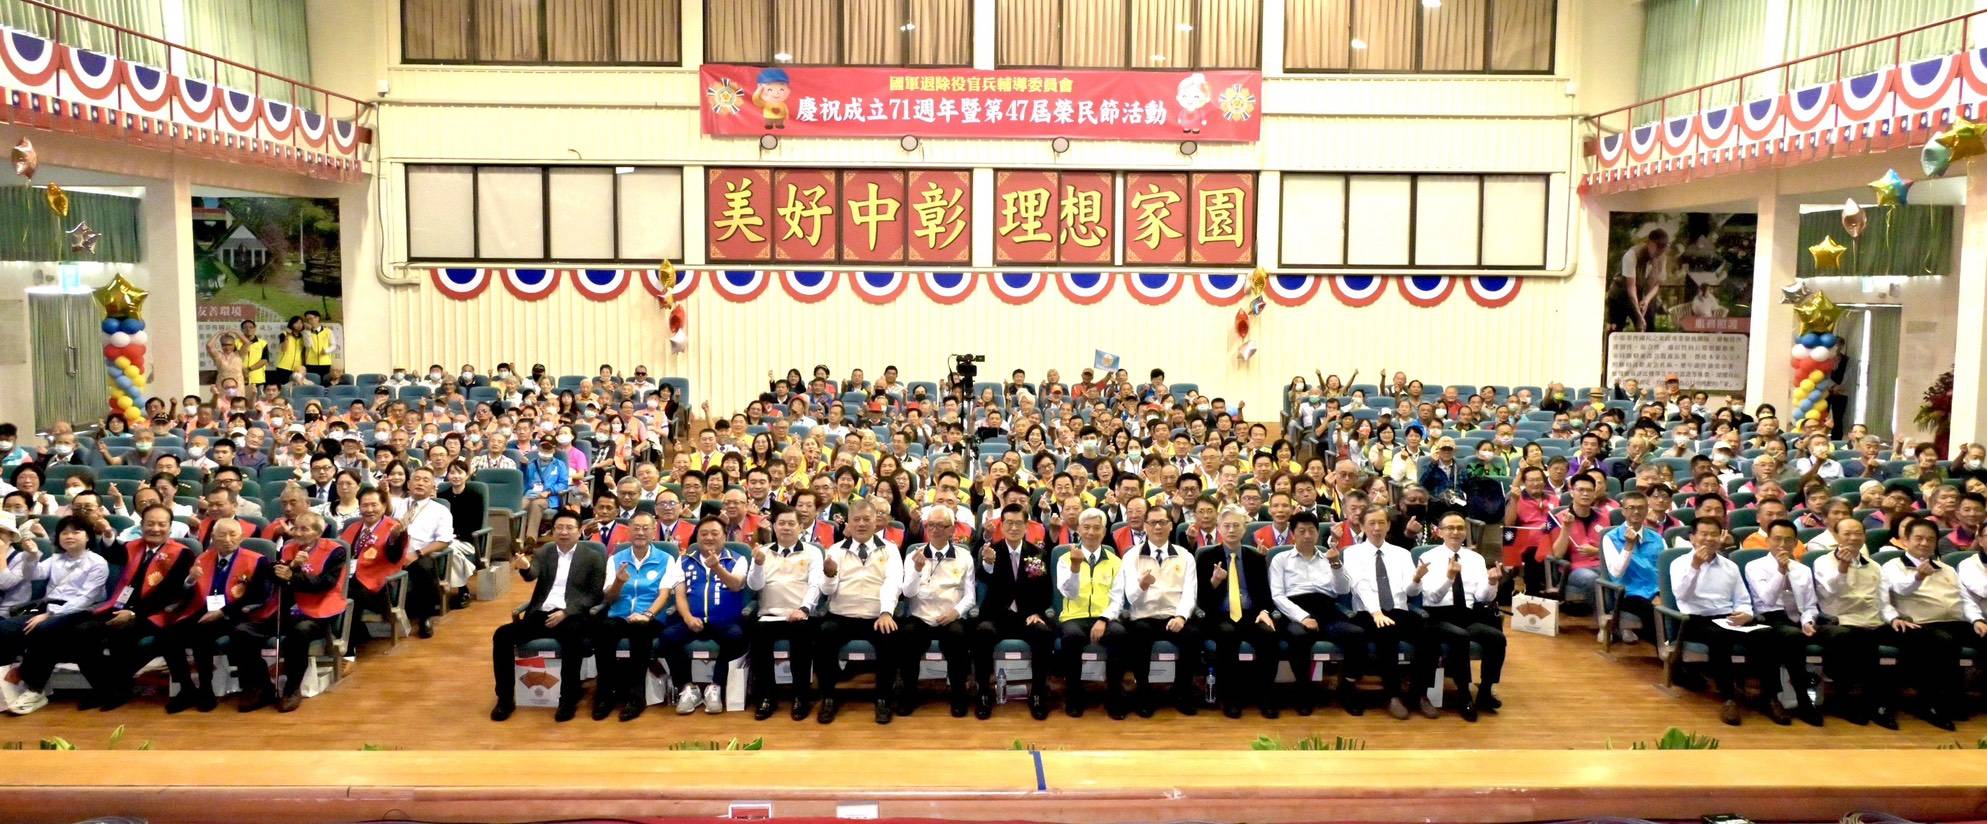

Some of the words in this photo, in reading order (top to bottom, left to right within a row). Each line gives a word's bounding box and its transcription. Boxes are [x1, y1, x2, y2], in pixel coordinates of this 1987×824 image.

[889, 75, 1073, 92] 國軍退除役官兵輔導委員會
[796, 97, 1168, 125] 慶祝成立71週年暨第47屆榮民節活動
[713, 177, 968, 248] 美好中彰
[1000, 184, 1246, 248] 理想家園
